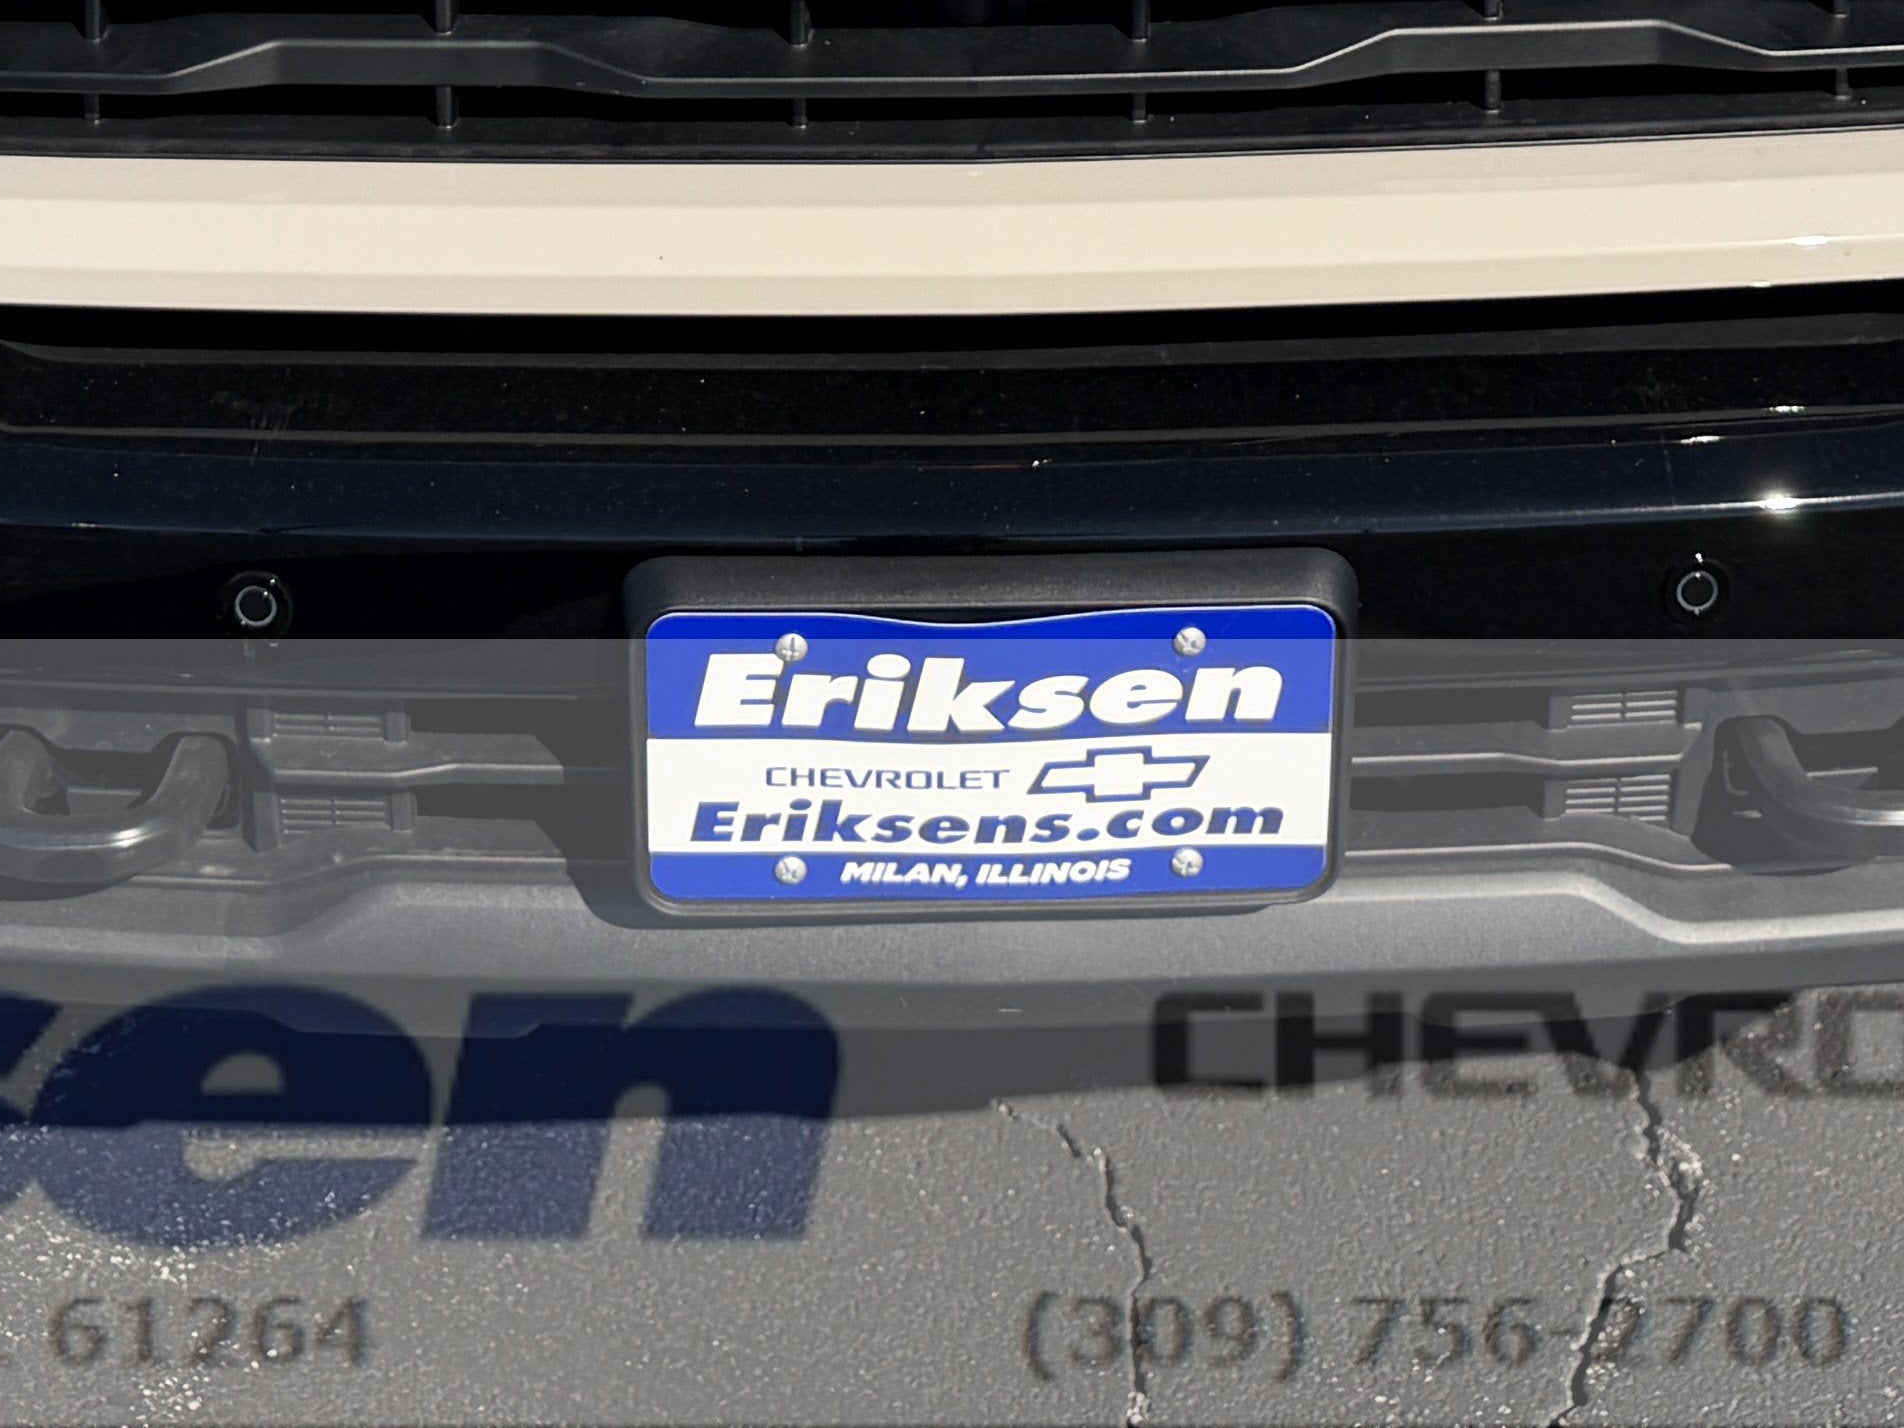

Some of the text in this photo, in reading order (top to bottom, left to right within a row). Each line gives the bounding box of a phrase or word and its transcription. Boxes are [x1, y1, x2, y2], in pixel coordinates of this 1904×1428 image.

[694, 653, 1284, 734] Eriksen
[765, 766, 1011, 791] CHEVROLET
[689, 798, 1285, 845] Eriksens.com
[840, 858, 1131, 888] MILAN, ILLINOIS
